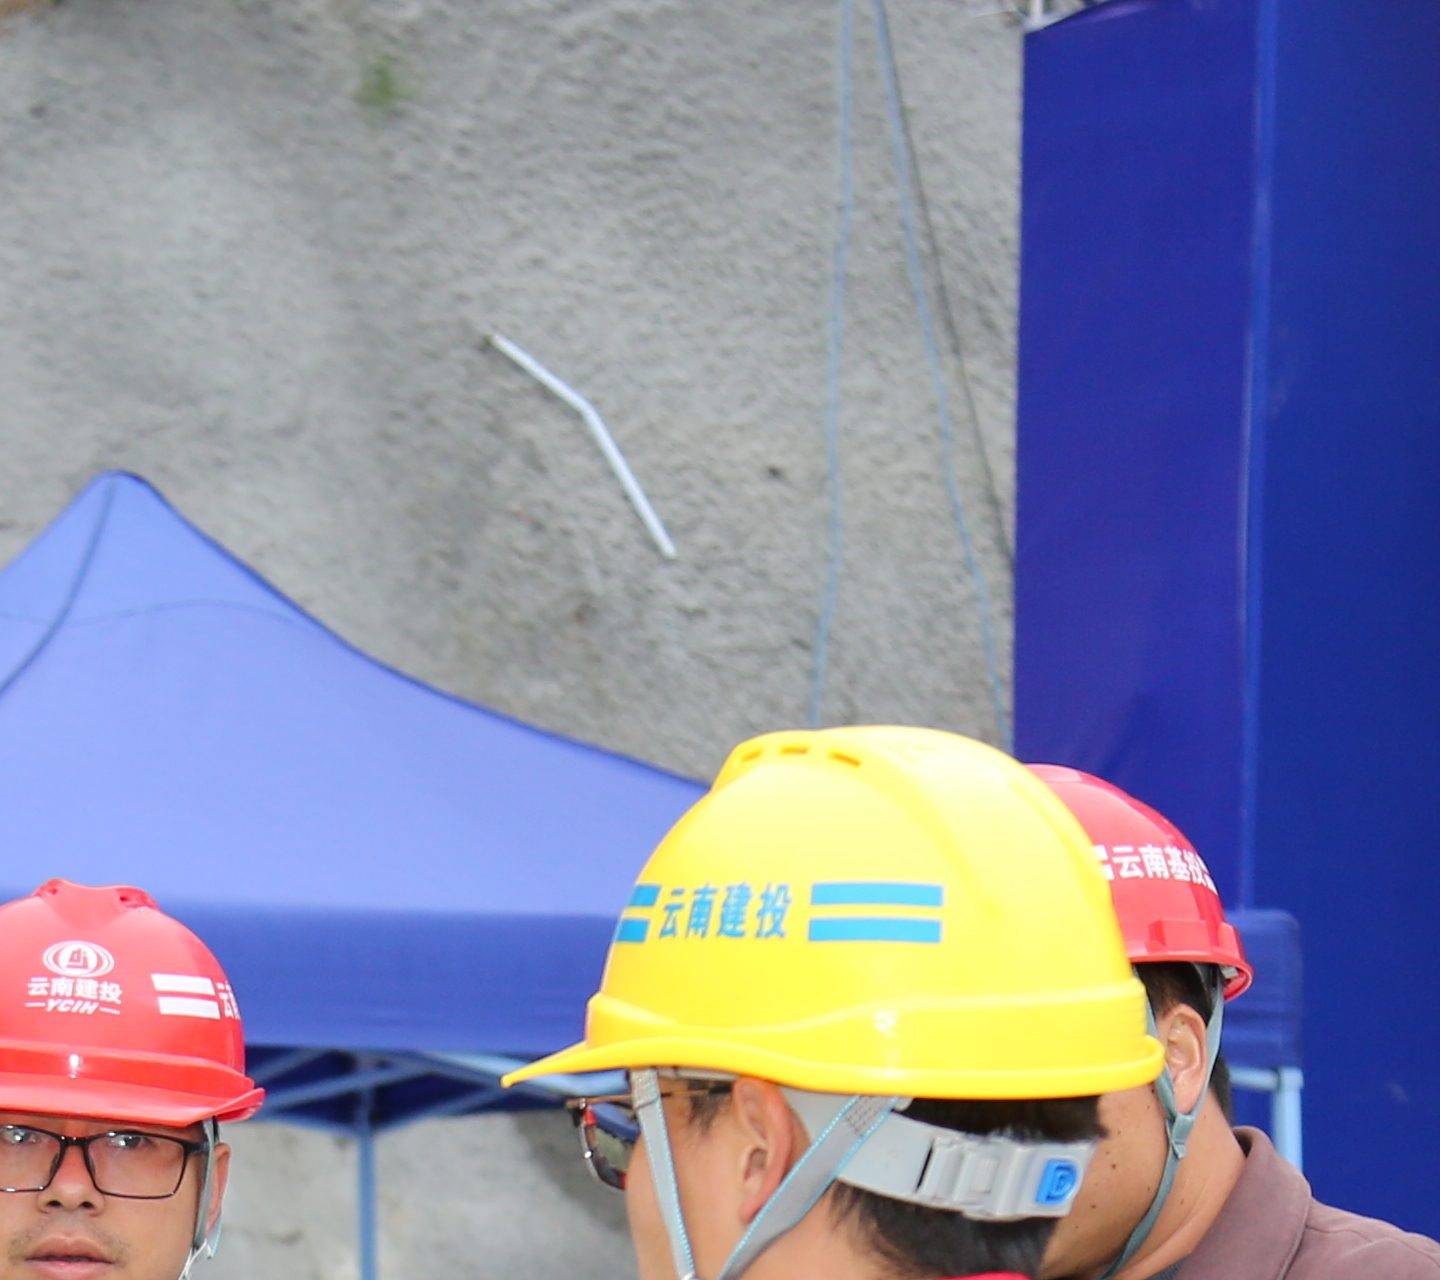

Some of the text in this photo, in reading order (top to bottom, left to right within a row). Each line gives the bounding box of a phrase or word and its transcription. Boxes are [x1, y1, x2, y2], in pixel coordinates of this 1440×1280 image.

[659, 882, 792, 938] 云南建投
[27, 976, 123, 1005] 云南建投
